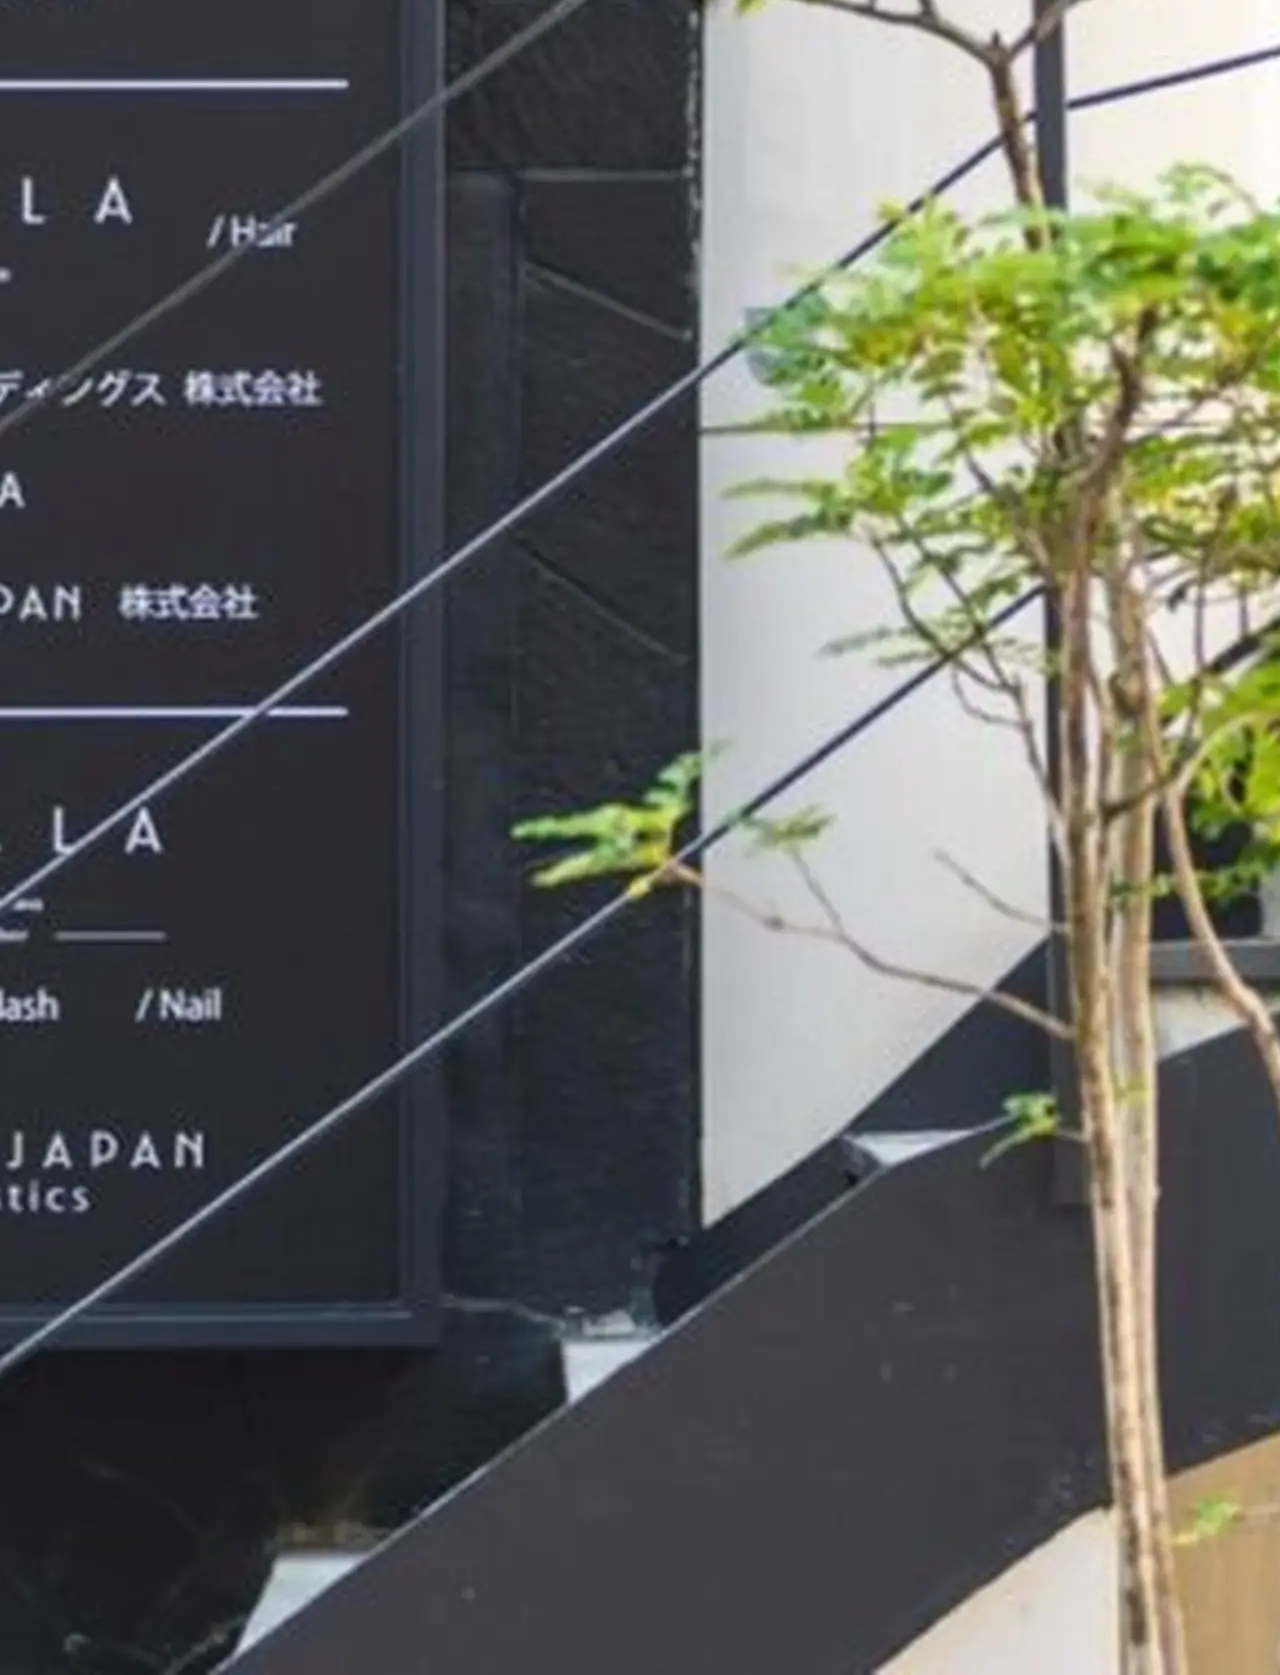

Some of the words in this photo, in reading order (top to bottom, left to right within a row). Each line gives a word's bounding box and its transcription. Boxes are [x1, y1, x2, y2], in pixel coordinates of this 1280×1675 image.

[183, 369, 322, 408] 株式会社
[119, 583, 258, 621] 株式会社
[6, 1130, 205, 1170] JAPAN
